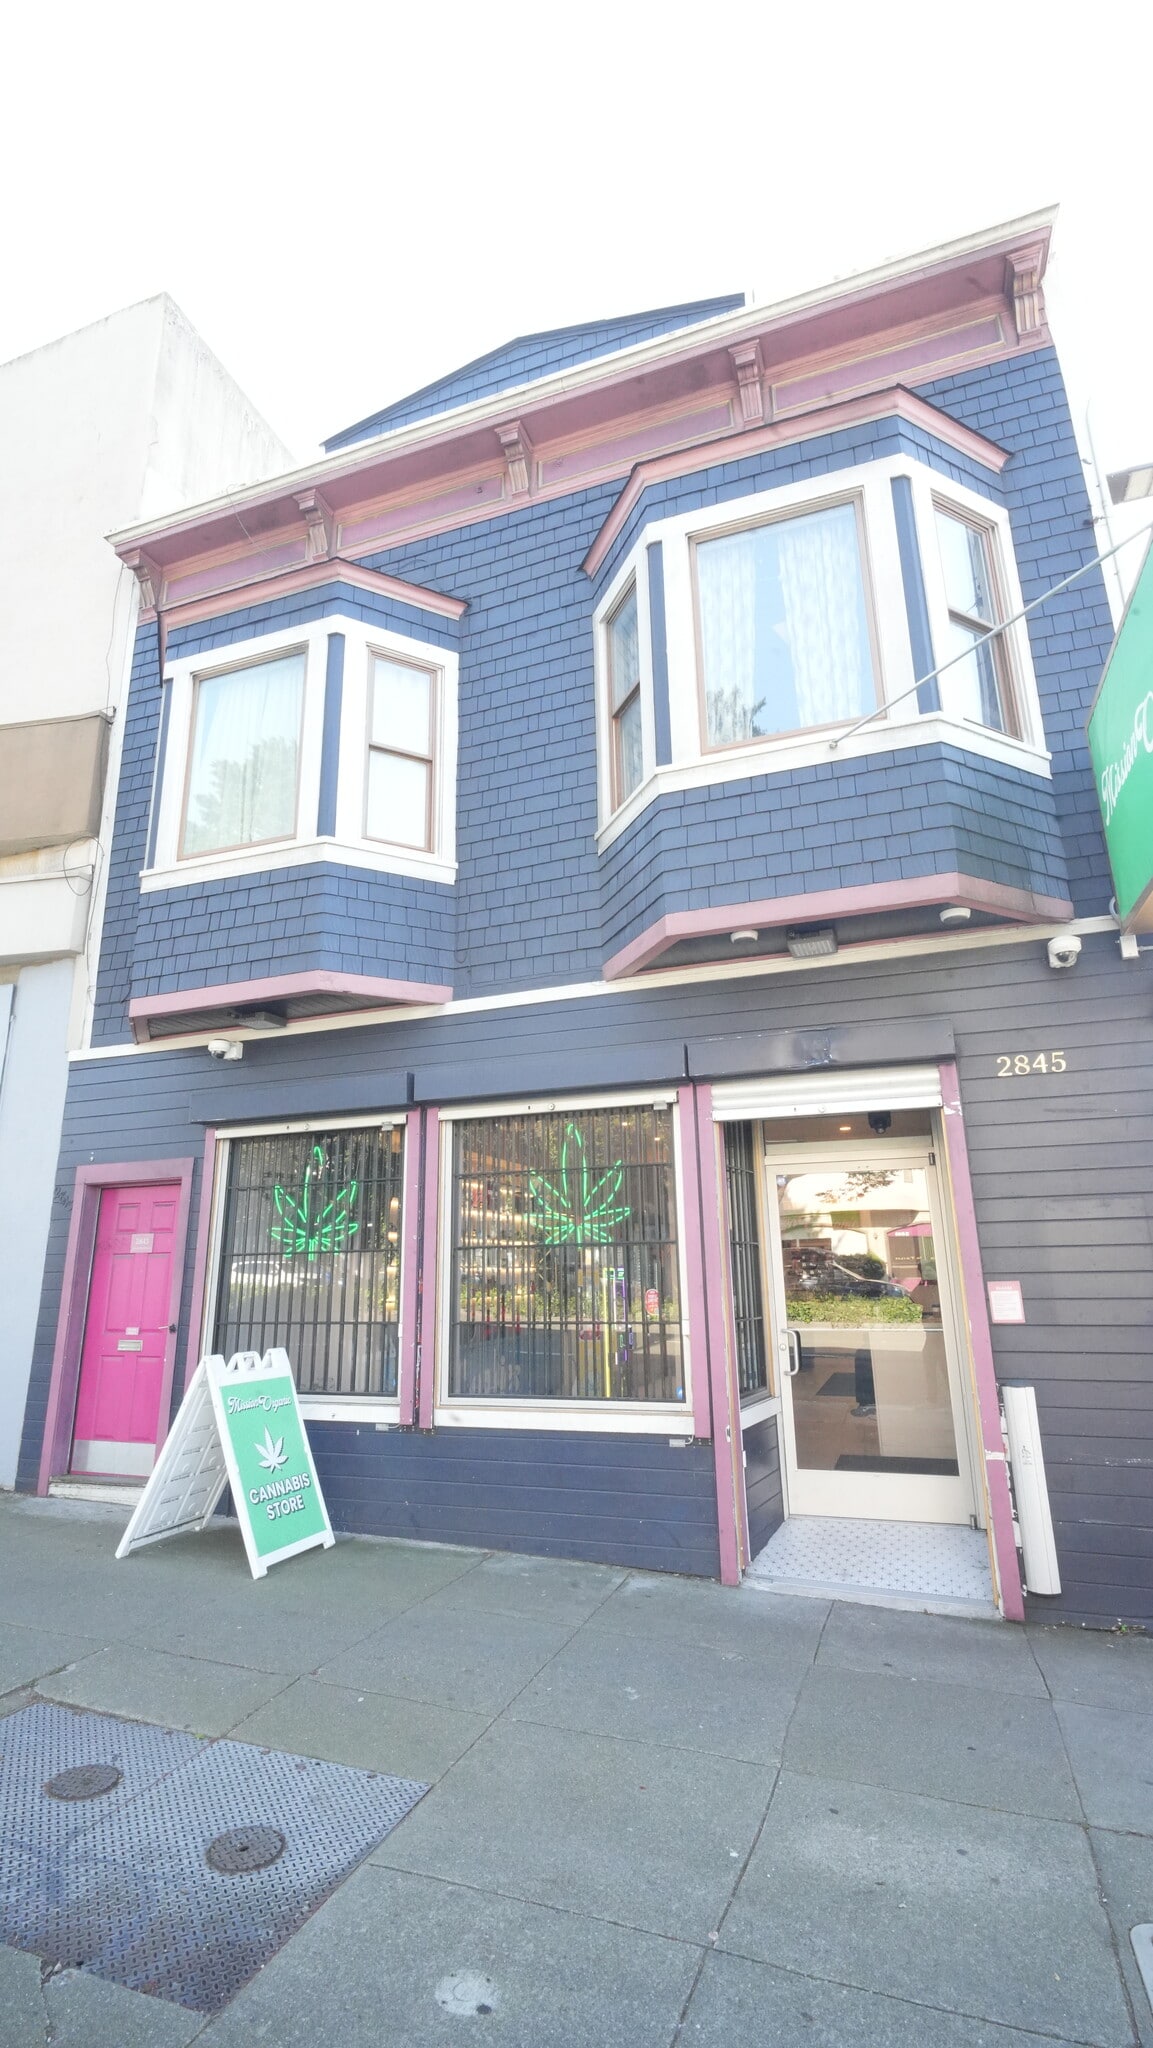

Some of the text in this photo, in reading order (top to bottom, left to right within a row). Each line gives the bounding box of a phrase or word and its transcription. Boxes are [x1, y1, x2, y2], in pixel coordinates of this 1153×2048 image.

[1101, 731, 1138, 826] Mission
[996, 1051, 1067, 1077] 2845
[228, 1396, 260, 1414] Mission
[249, 1472, 311, 1505] CANNABIS
[266, 1494, 305, 1521] STORE
